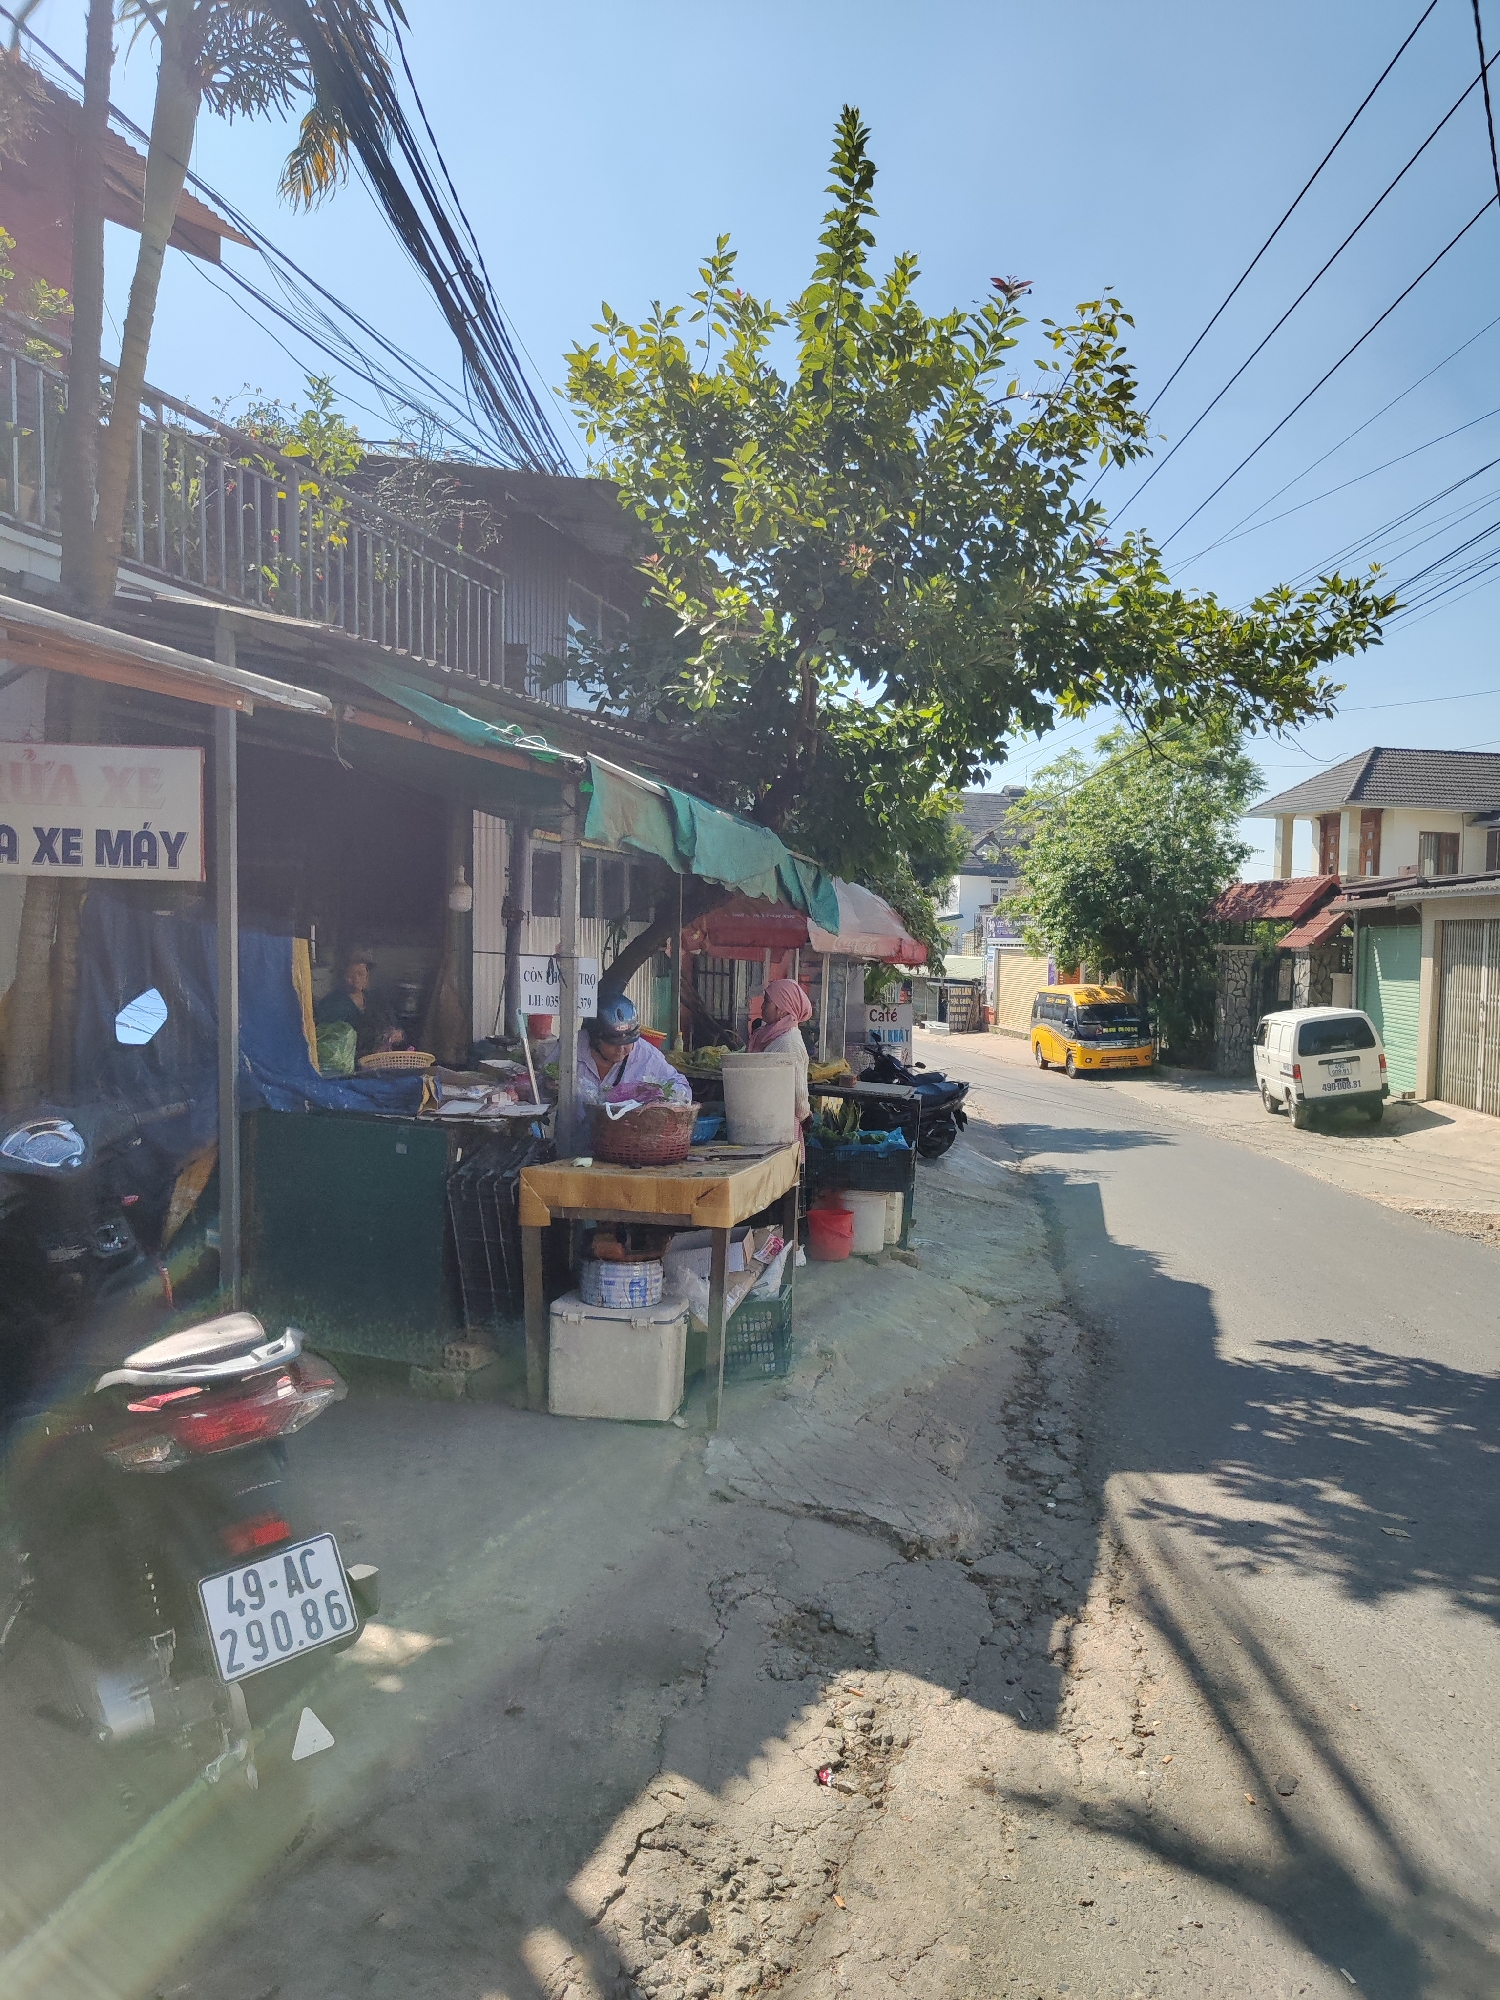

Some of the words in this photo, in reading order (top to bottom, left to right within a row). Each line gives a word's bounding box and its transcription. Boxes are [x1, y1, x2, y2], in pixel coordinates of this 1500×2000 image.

[0, 748, 84, 807] ỬA
[97, 767, 166, 809] XE
[32, 827, 83, 866] XE
[95, 821, 188, 869] MÁY
[579, 973, 596, 989] TRỌ
[869, 1008, 898, 1022] Café
[227, 1548, 322, 1617] 49-AC
[220, 1590, 347, 1674] 290.86
